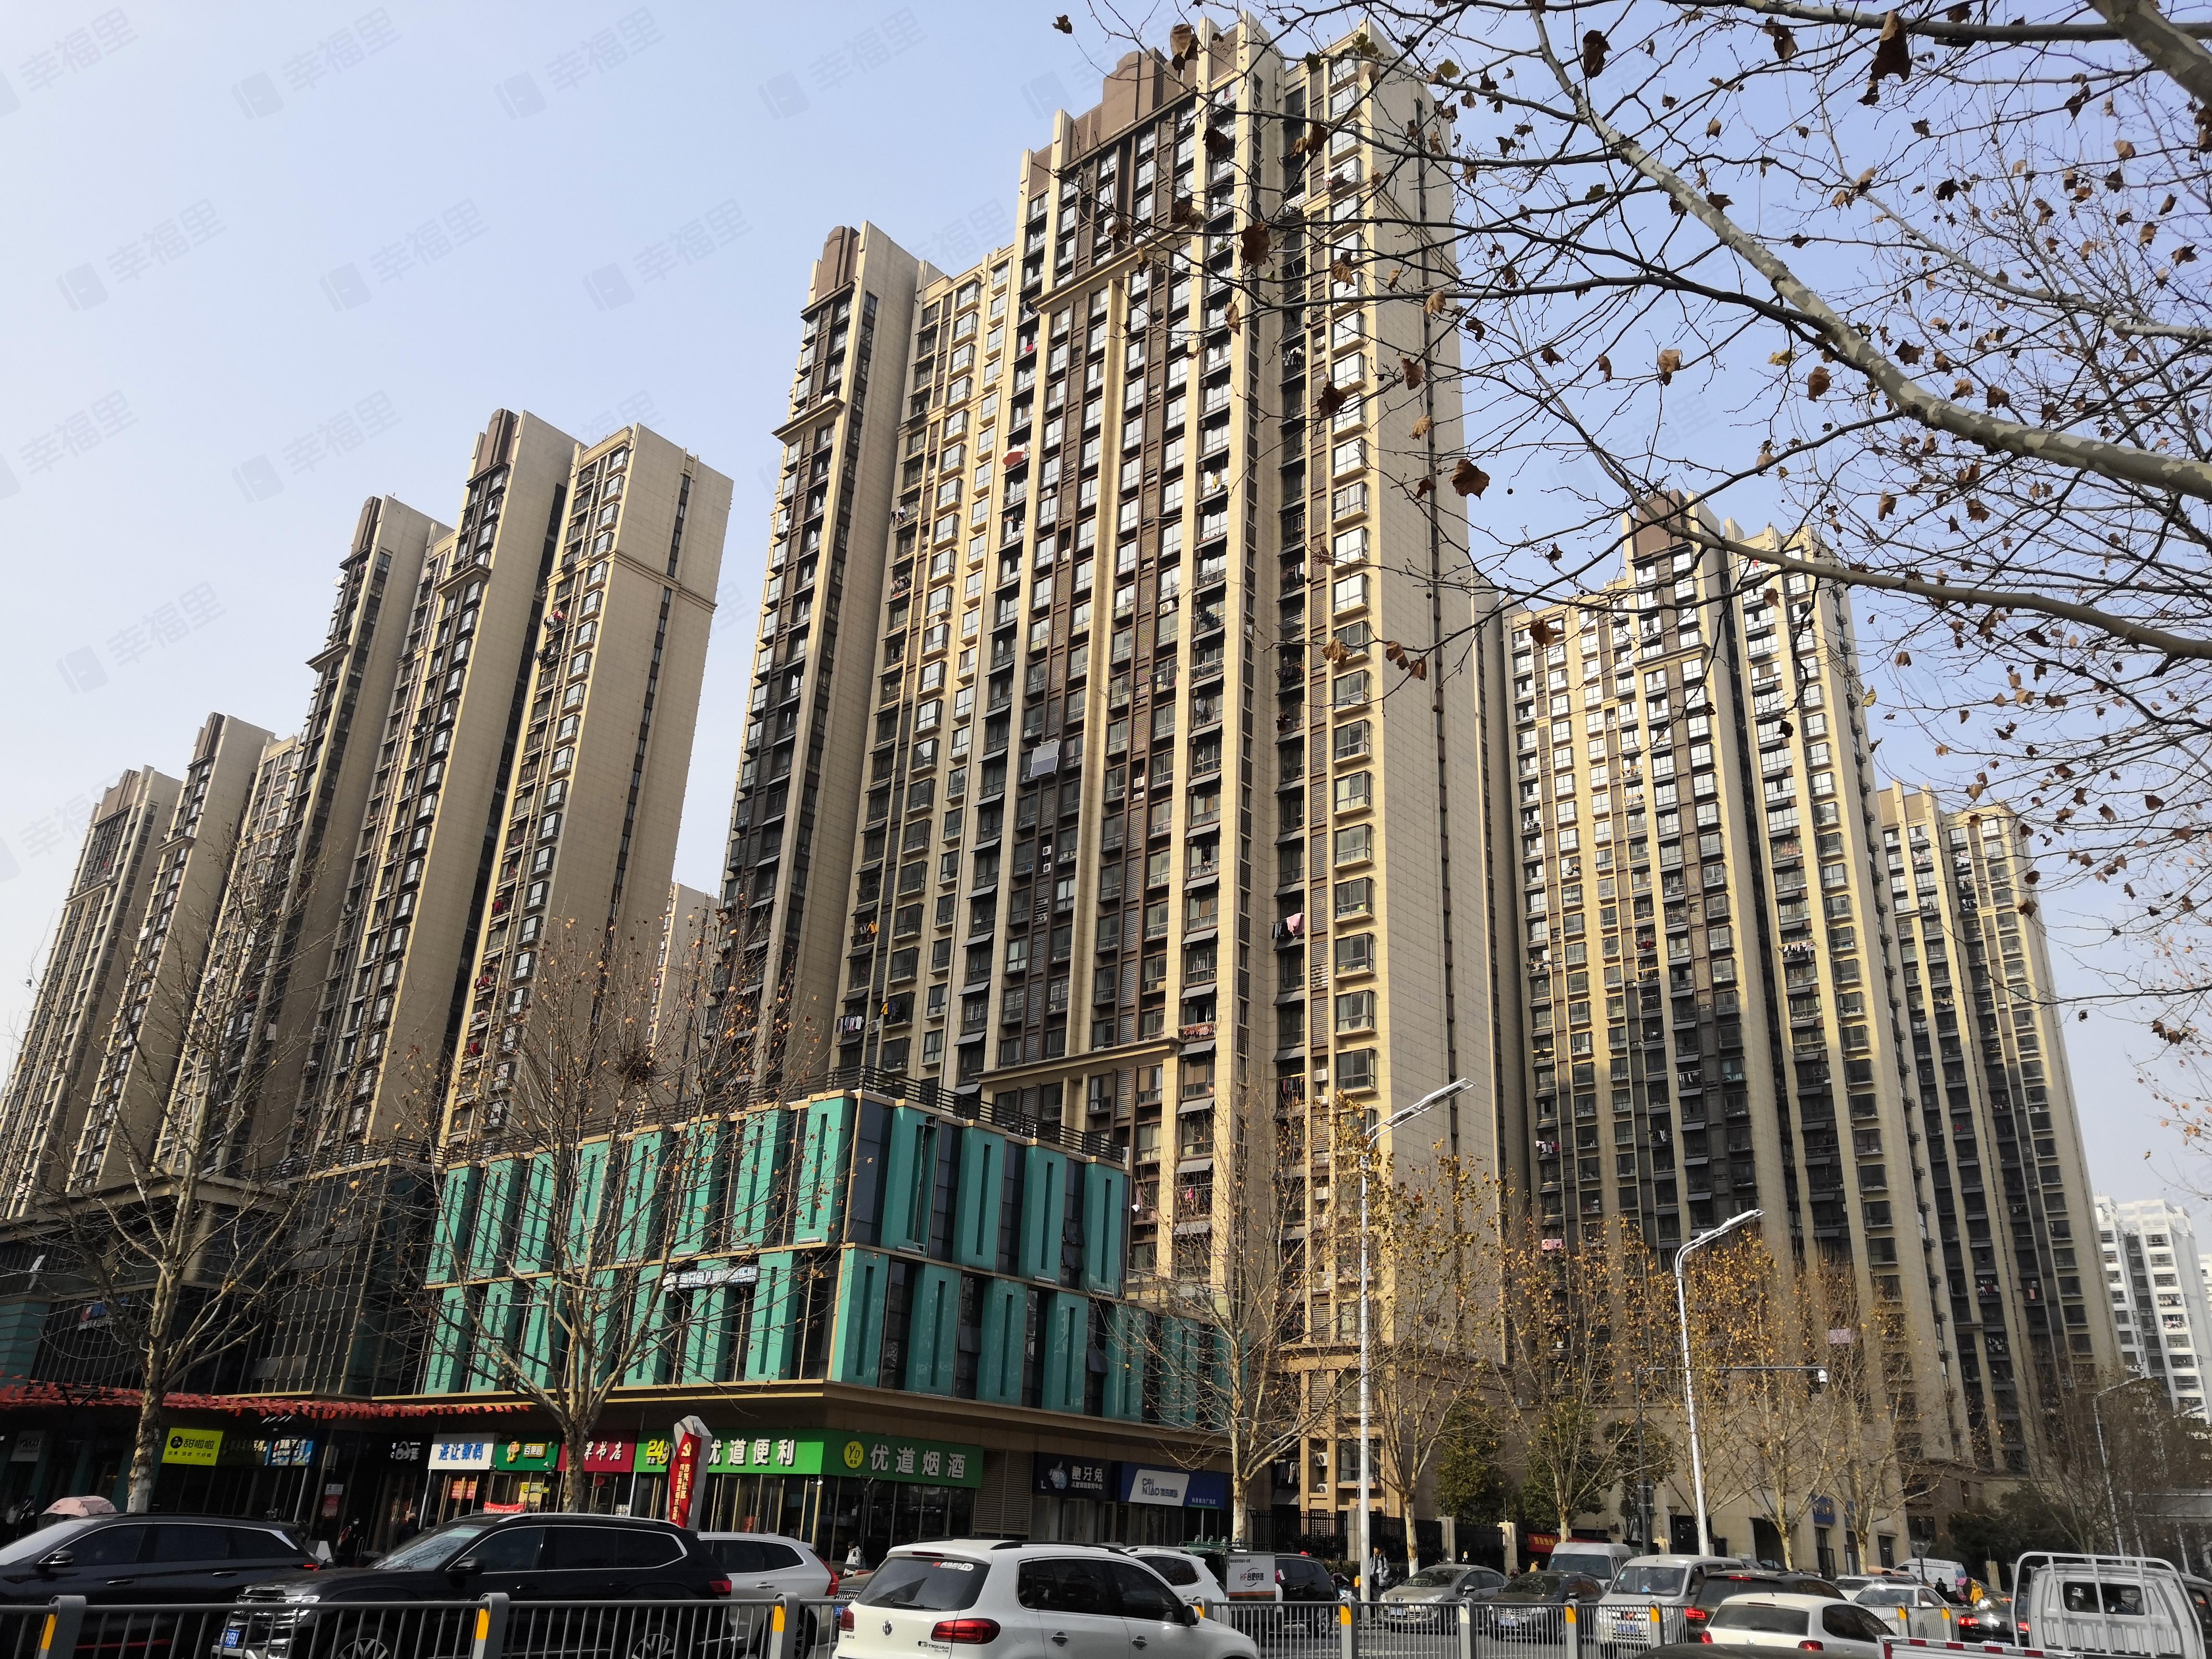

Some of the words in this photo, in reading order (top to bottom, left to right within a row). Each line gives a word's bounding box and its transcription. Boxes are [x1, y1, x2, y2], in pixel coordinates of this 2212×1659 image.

[184, 1438, 215, 1449] 甜啦啦
[524, 1444, 544, 1456] 百果园
[646, 1439, 665, 1460] 24
[849, 1445, 860, 1459] YD
[871, 1444, 965, 1479] 优道烟酒
